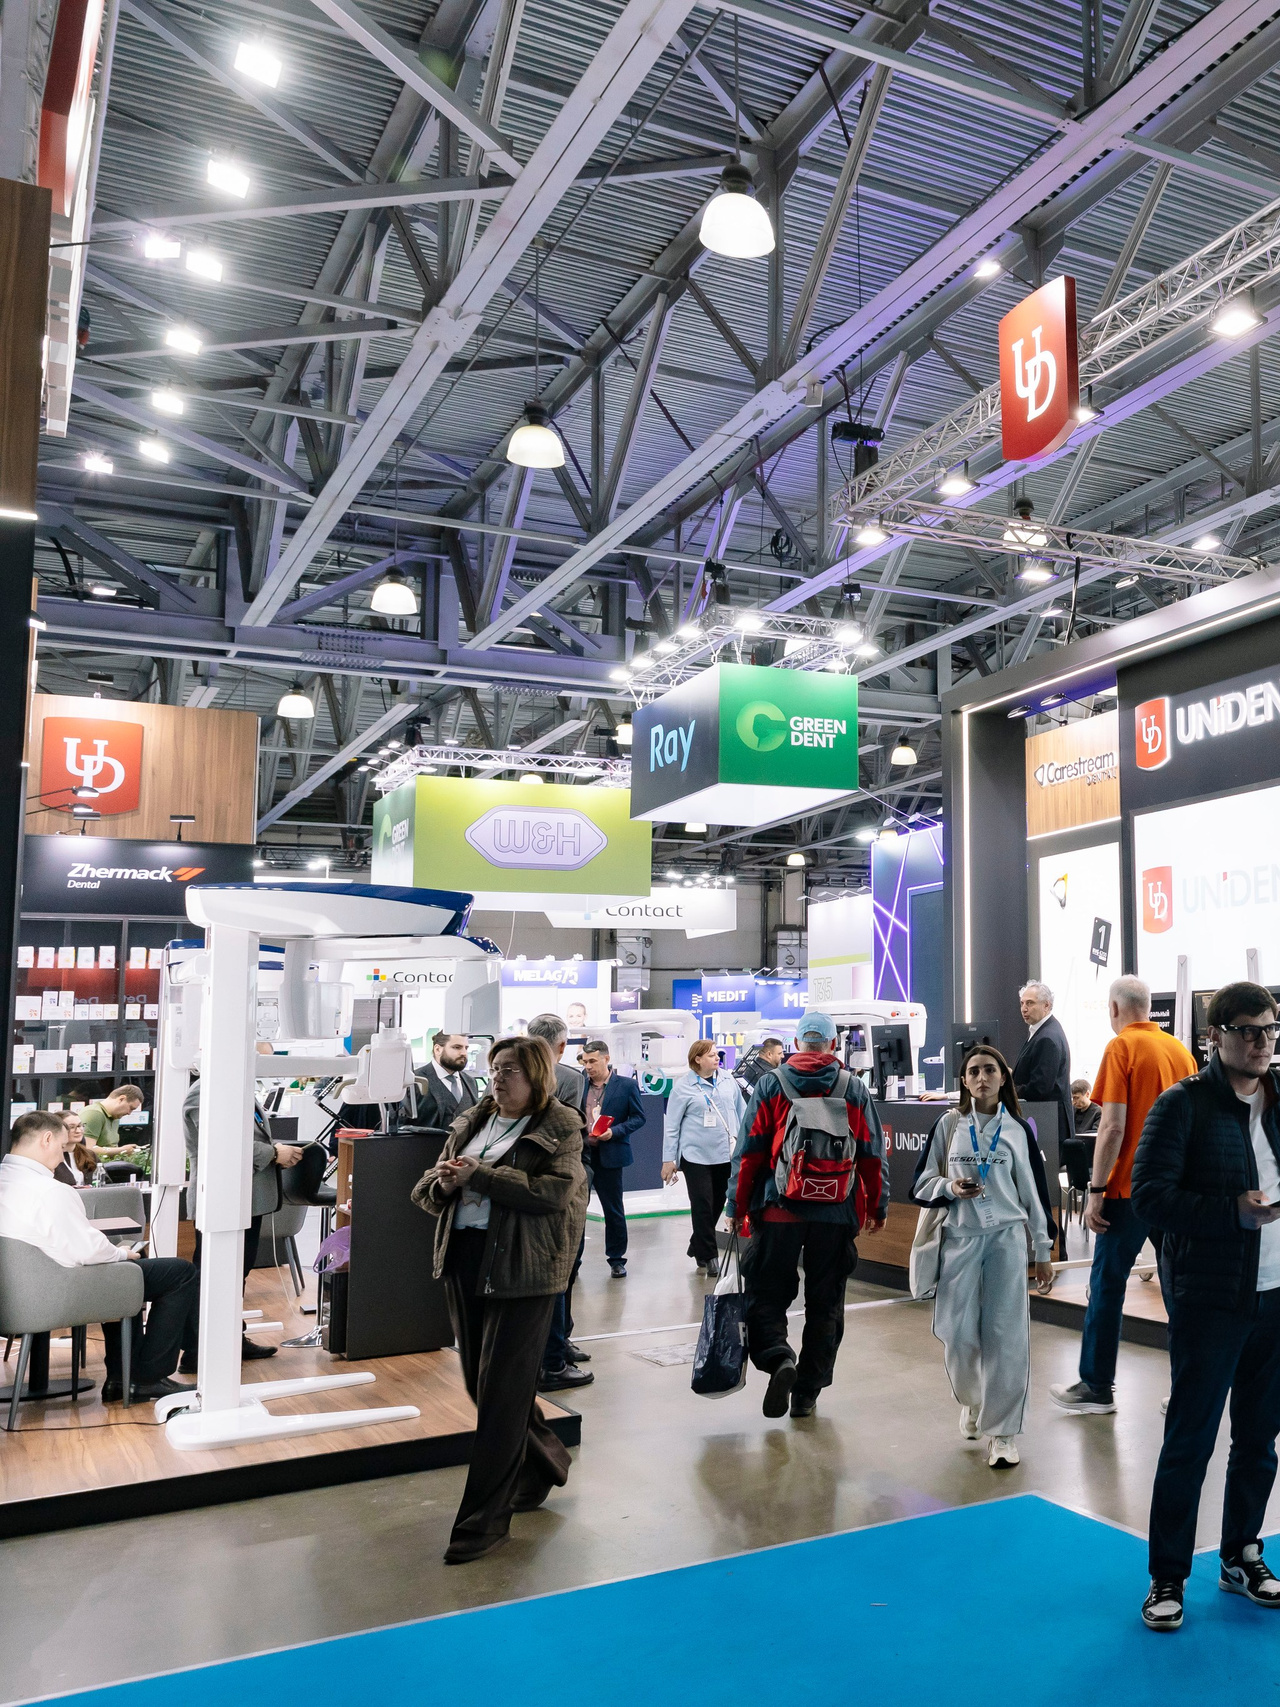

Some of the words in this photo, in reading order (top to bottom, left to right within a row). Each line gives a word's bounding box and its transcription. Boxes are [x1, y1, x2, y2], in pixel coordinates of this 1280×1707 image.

[790, 716, 847, 734] GREEN
[649, 720, 695, 772] Ray
[790, 732, 837, 749] DENT
[1047, 752, 1115, 783] Carestream
[1086, 768, 1117, 786] DENTAL
[493, 818, 581, 856] W&H
[67, 863, 174, 882] Zhermack
[67, 880, 100, 889] Dental
[706, 990, 748, 1002] MEDIT
